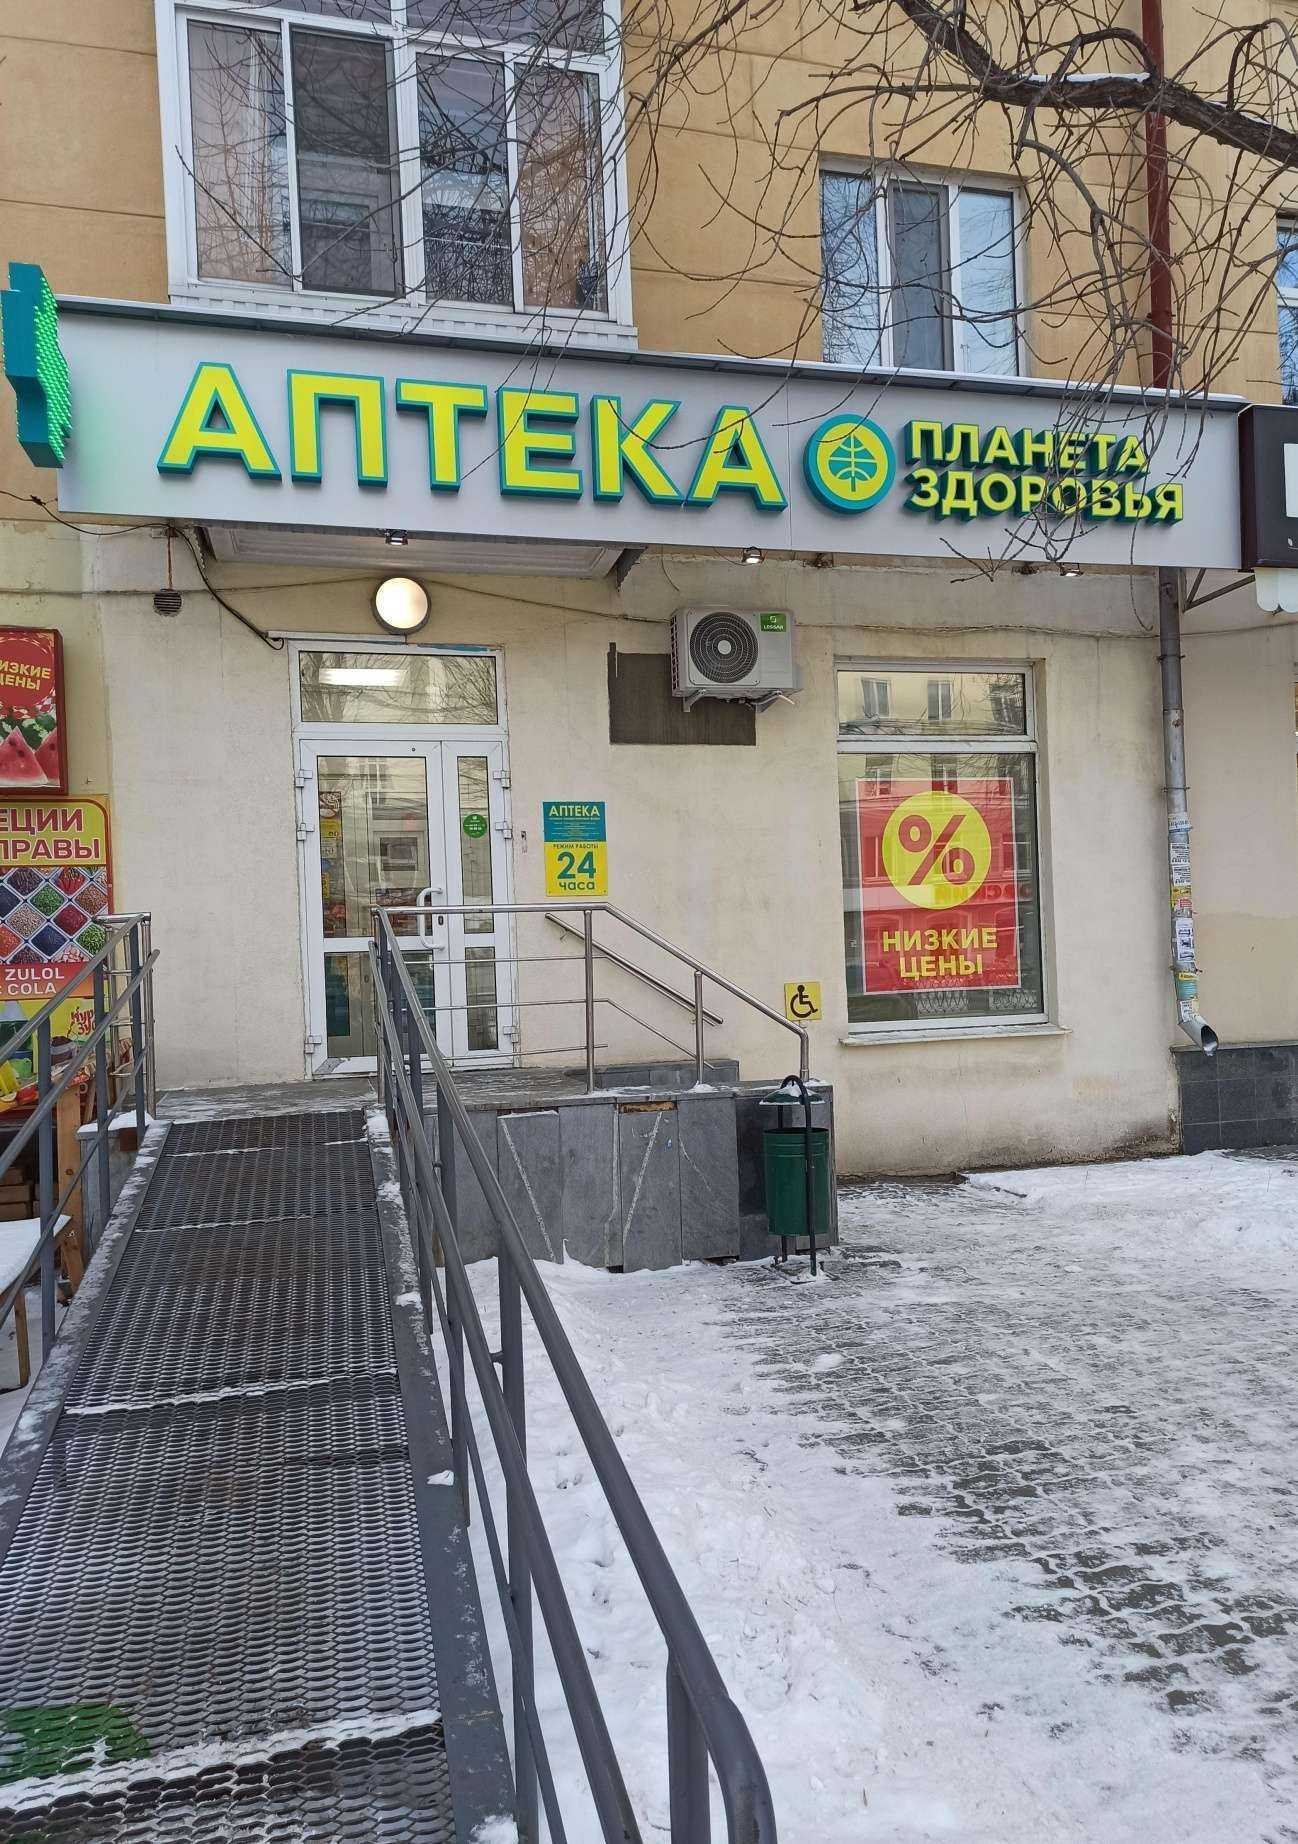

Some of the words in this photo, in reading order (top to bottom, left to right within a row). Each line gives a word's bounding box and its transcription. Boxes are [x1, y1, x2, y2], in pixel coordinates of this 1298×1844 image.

[156, 361, 788, 512] АПТЕКА
[906, 420, 1150, 475] ПЛАНЕТА
[905, 469, 1184, 525] ЗДОРОВЬЯ
[549, 805, 600, 817] АПТЕКА
[557, 851, 596, 880] 24
[559, 881, 595, 891] часа
[882, 928, 998, 952] НИЗКИЕ
[5, 967, 65, 981] ZULOL
[900, 954, 983, 981] ЦЕНЫ
[7, 982, 57, 996] COLA
